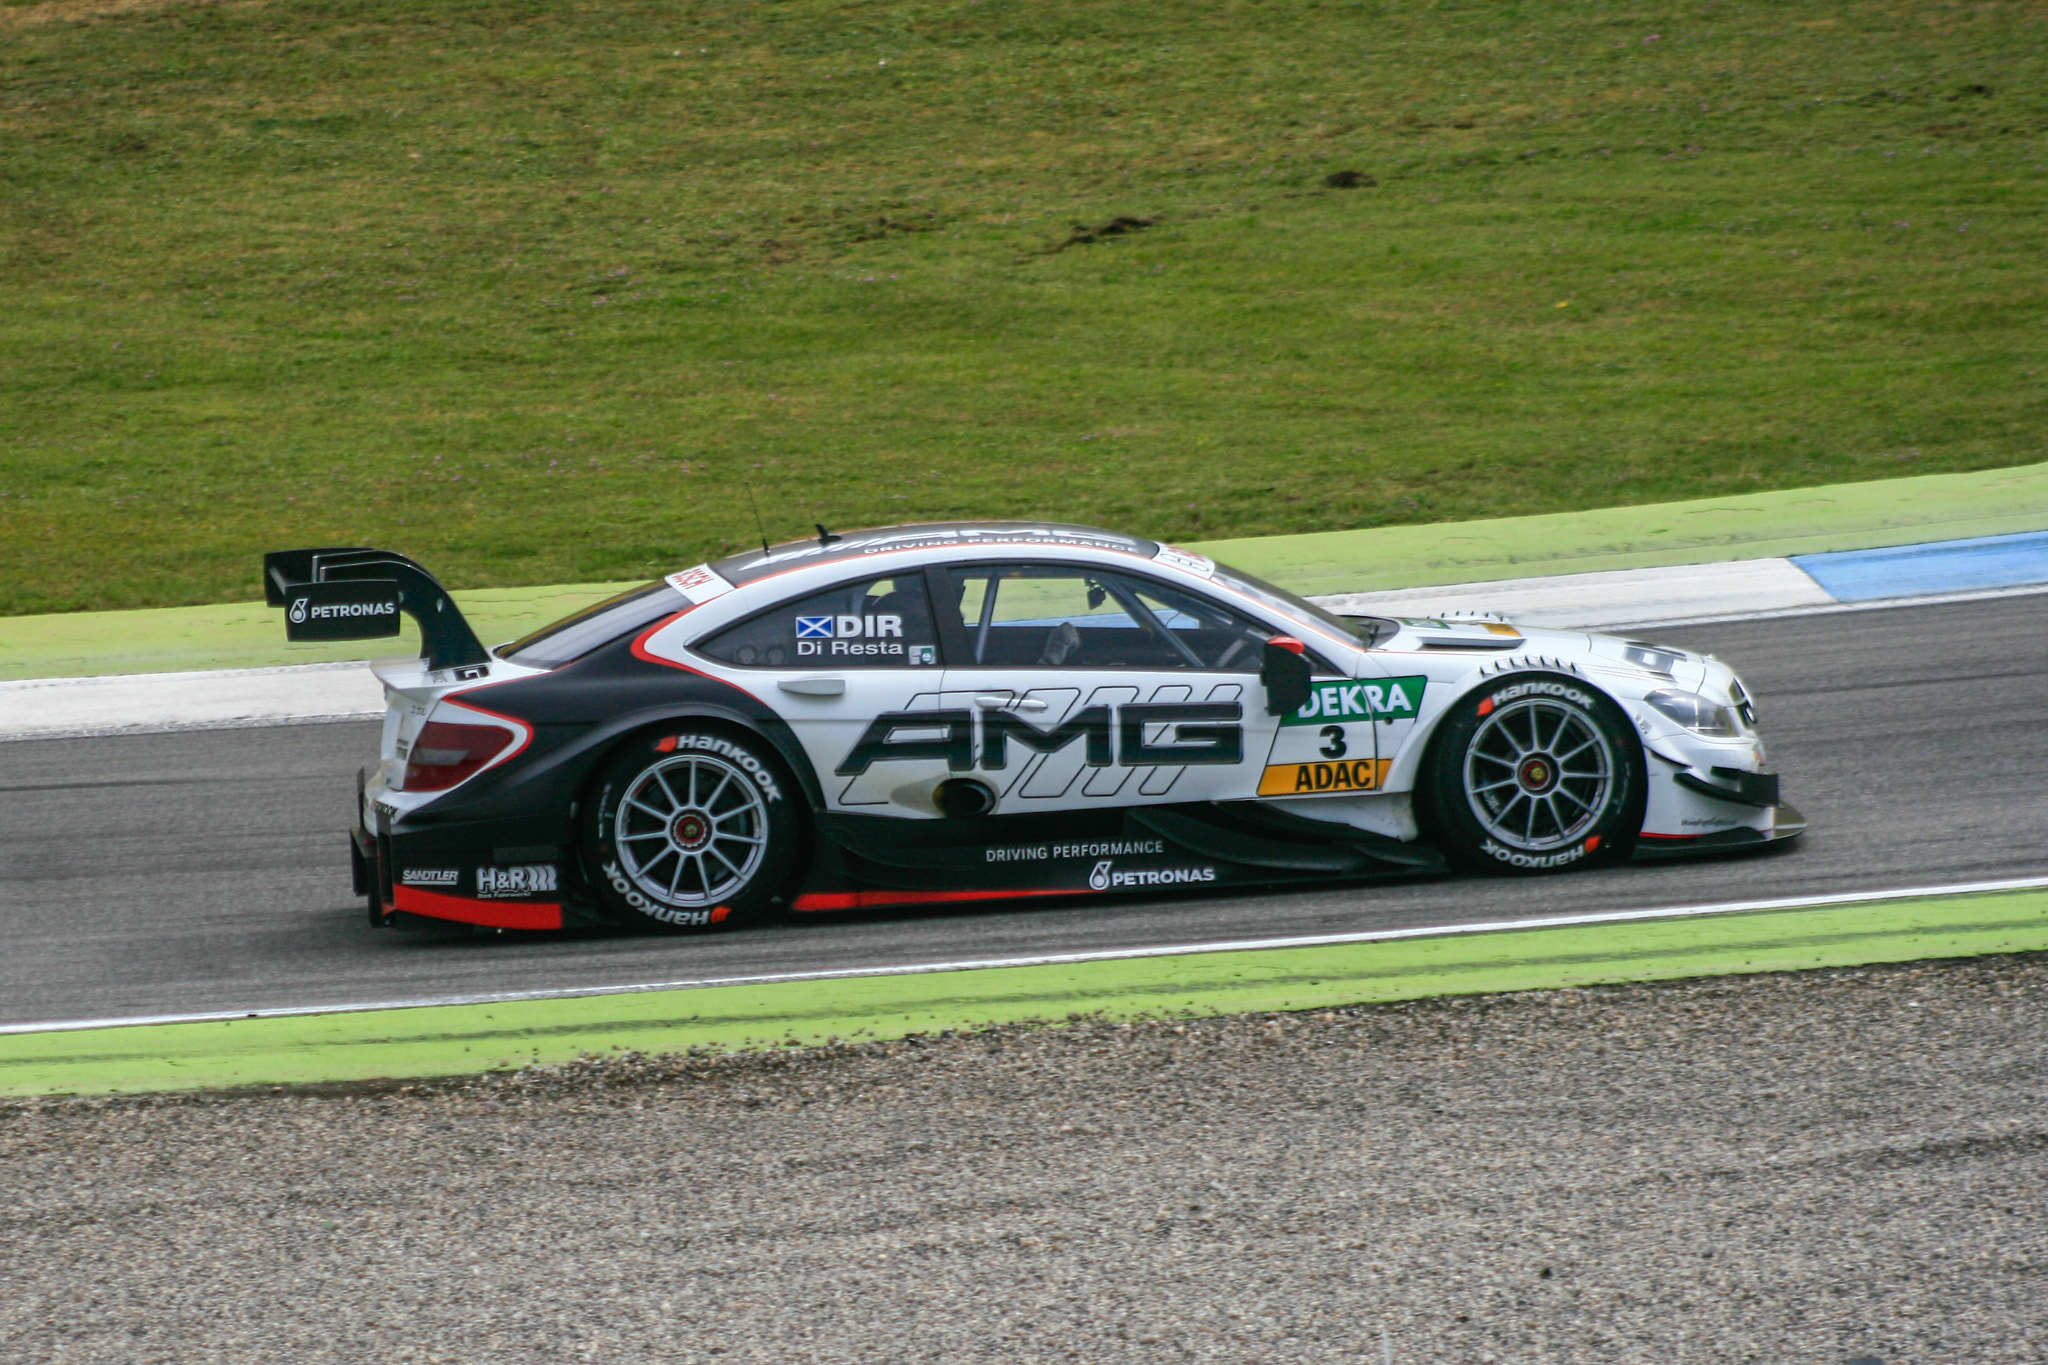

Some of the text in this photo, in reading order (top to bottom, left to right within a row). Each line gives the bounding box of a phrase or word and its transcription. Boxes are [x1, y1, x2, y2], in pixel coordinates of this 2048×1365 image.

[863, 537, 1139, 554] DRIVING PERFORMANCE
[310, 602, 395, 619] PETRONAS
[836, 615, 903, 638] DIR
[797, 640, 904, 655] Di Resta
[1298, 683, 1413, 718] DEKRA
[834, 701, 1243, 776] AMG
[1318, 725, 1347, 759] 3
[1295, 761, 1371, 791] ADAC
[986, 840, 1164, 862] DRIVING PERFORMANCE
[402, 869, 459, 882] SANDTLER
[475, 866, 529, 892] H&R
[1111, 868, 1216, 887] PETRONAS
